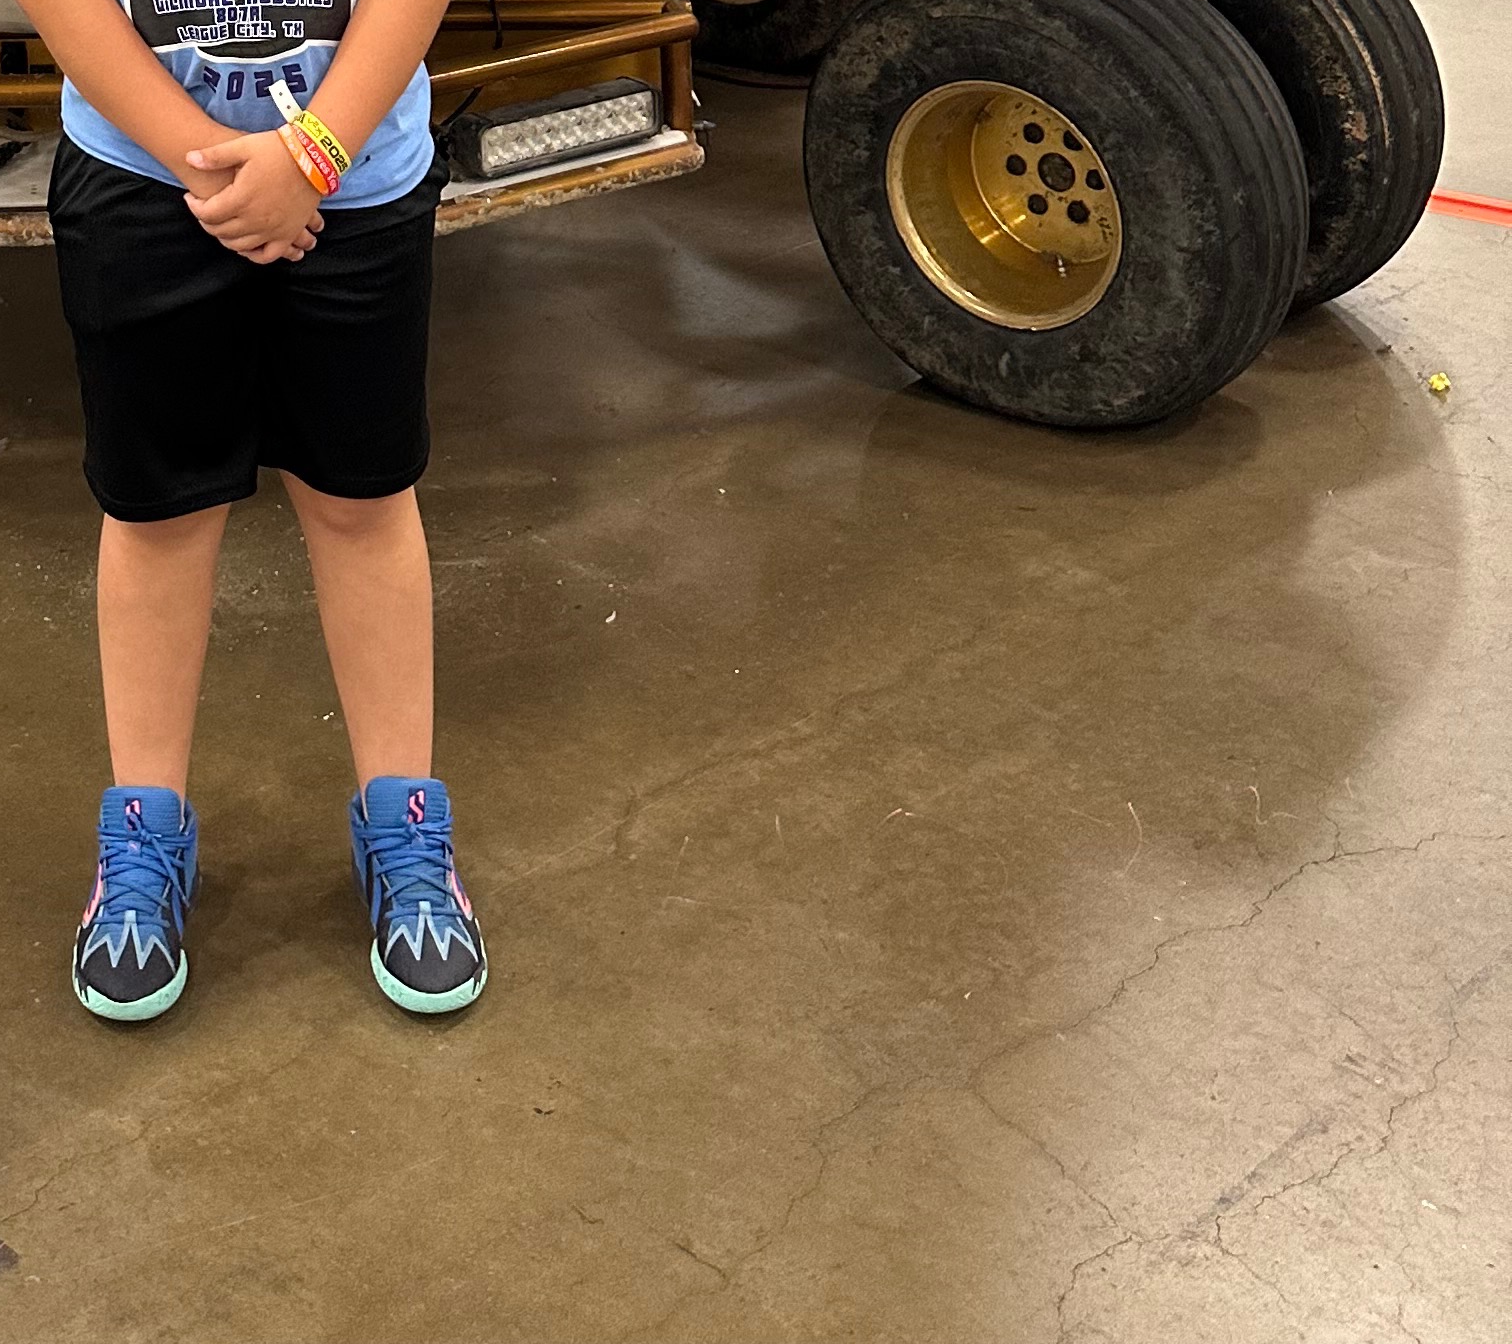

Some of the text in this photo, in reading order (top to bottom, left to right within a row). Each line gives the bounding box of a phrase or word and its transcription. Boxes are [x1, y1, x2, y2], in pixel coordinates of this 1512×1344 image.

[214, 6, 262, 23] 807A
[282, 21, 305, 38] TX
[203, 63, 308, 101] 2025
[306, 143, 331, 175] Loves
